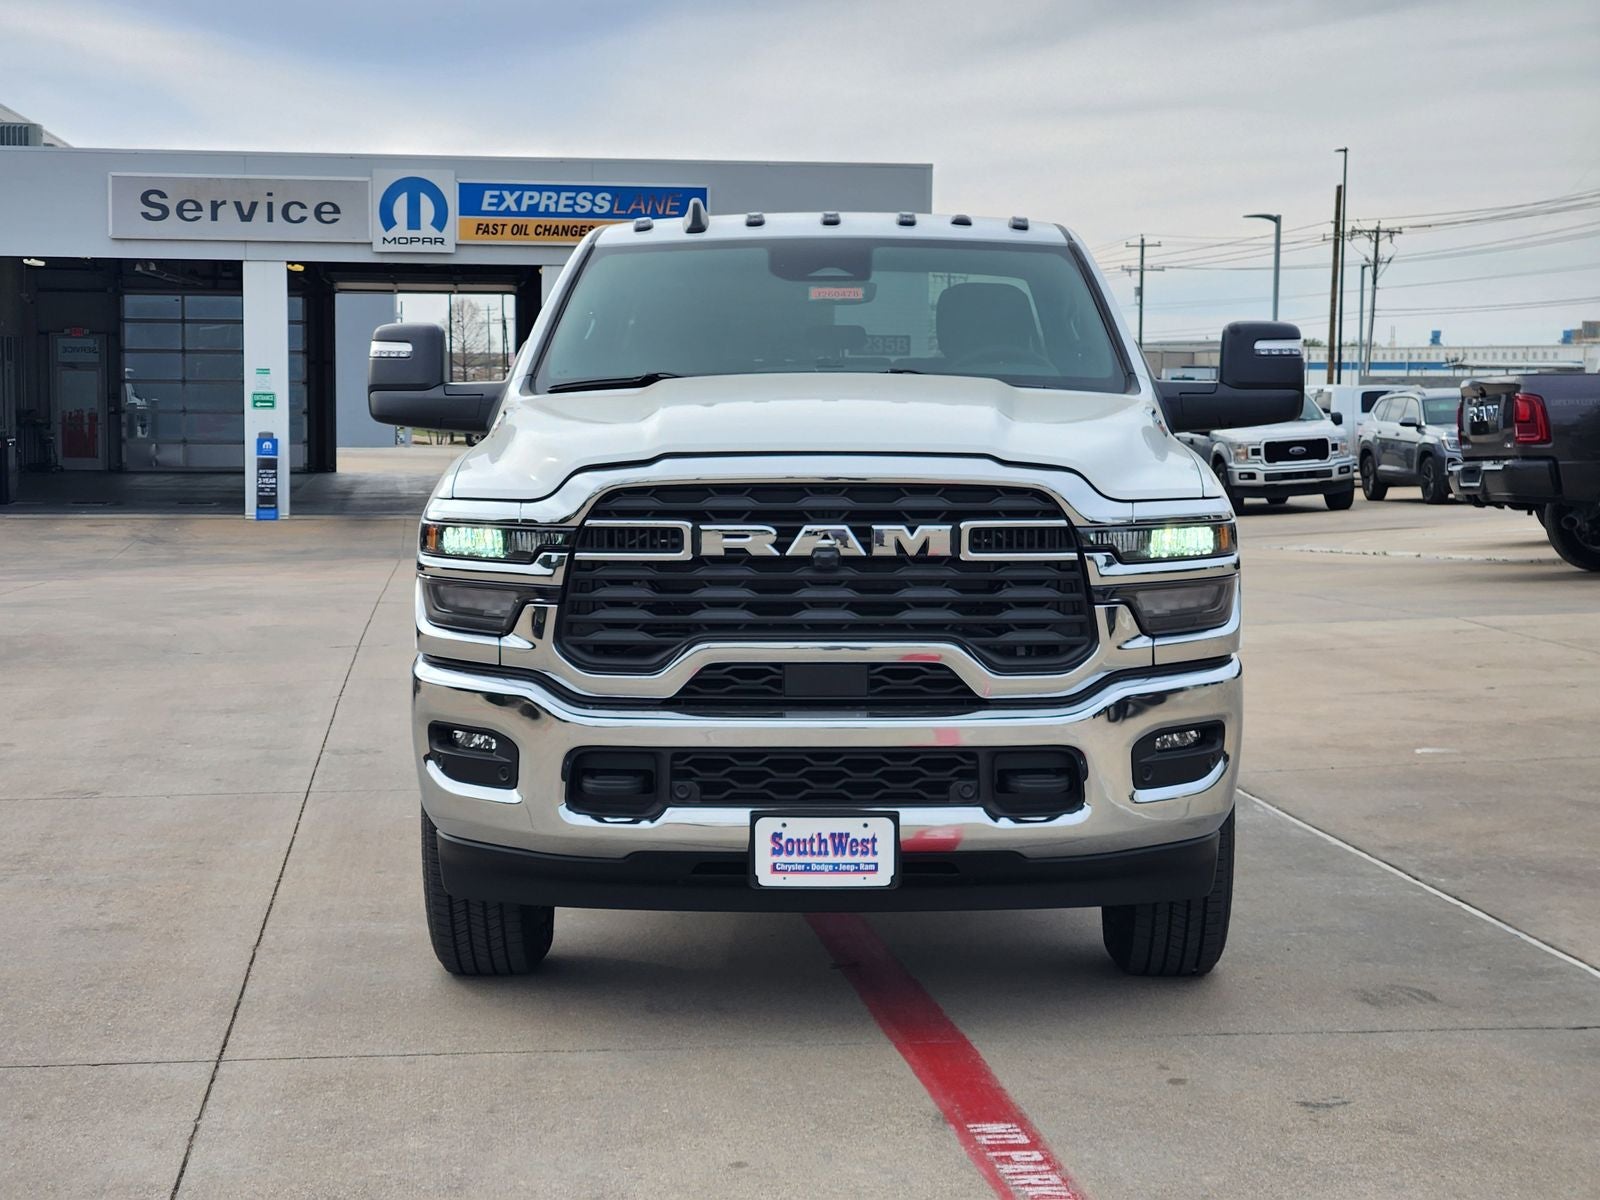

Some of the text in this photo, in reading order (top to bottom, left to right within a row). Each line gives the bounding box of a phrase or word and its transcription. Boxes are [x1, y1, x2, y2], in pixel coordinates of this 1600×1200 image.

[140, 188, 342, 225] Service
[475, 223, 507, 236] FAST
[511, 224, 531, 237] OIL
[382, 235, 446, 247] MOPAR
[1468, 404, 1499, 423] RAM
[699, 524, 953, 557] RAM
[775, 862, 876, 873] Chrysler Dodge Jeep Ram
[966, 1122, 1031, 1145] NO
